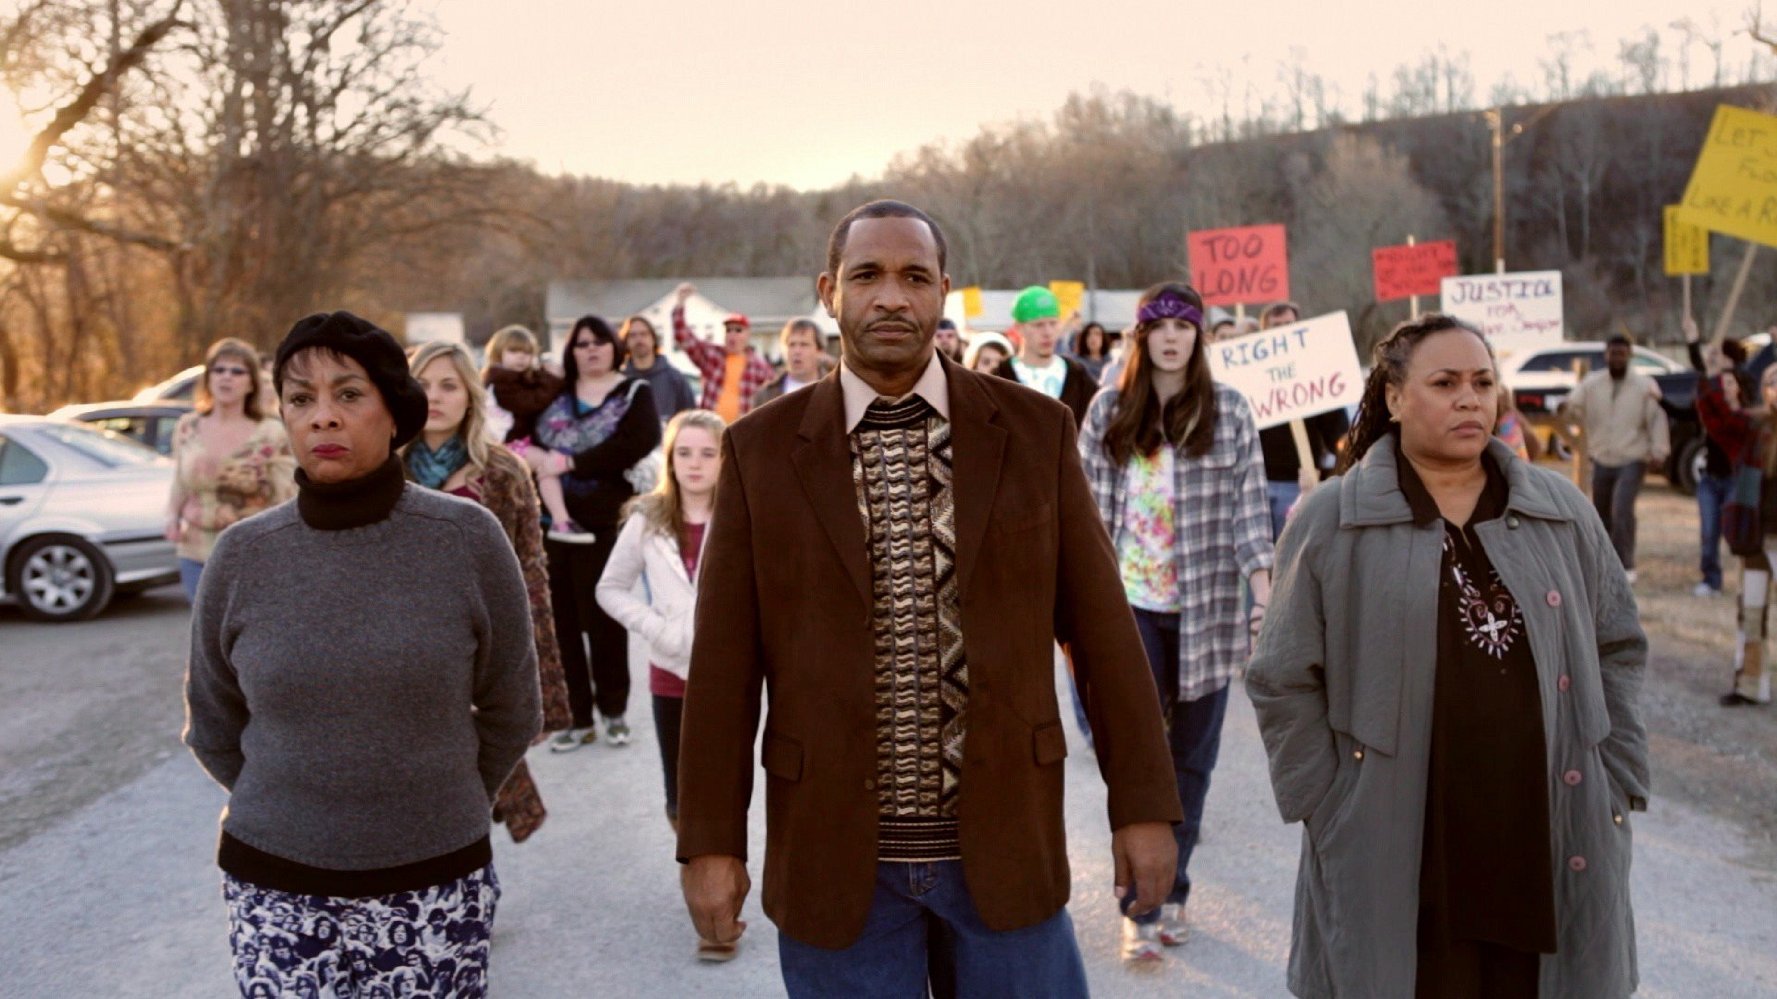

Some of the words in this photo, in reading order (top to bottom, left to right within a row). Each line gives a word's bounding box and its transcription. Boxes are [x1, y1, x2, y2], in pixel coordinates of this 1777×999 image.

[1714, 112, 1768, 147] LET
[1738, 156, 1777, 184] FLO
[1201, 233, 1263, 264] TOO
[1200, 263, 1279, 298] LONG
[1221, 327, 1310, 369] RIGHT
[1265, 362, 1296, 383] THE
[1248, 371, 1347, 419] WRONG
